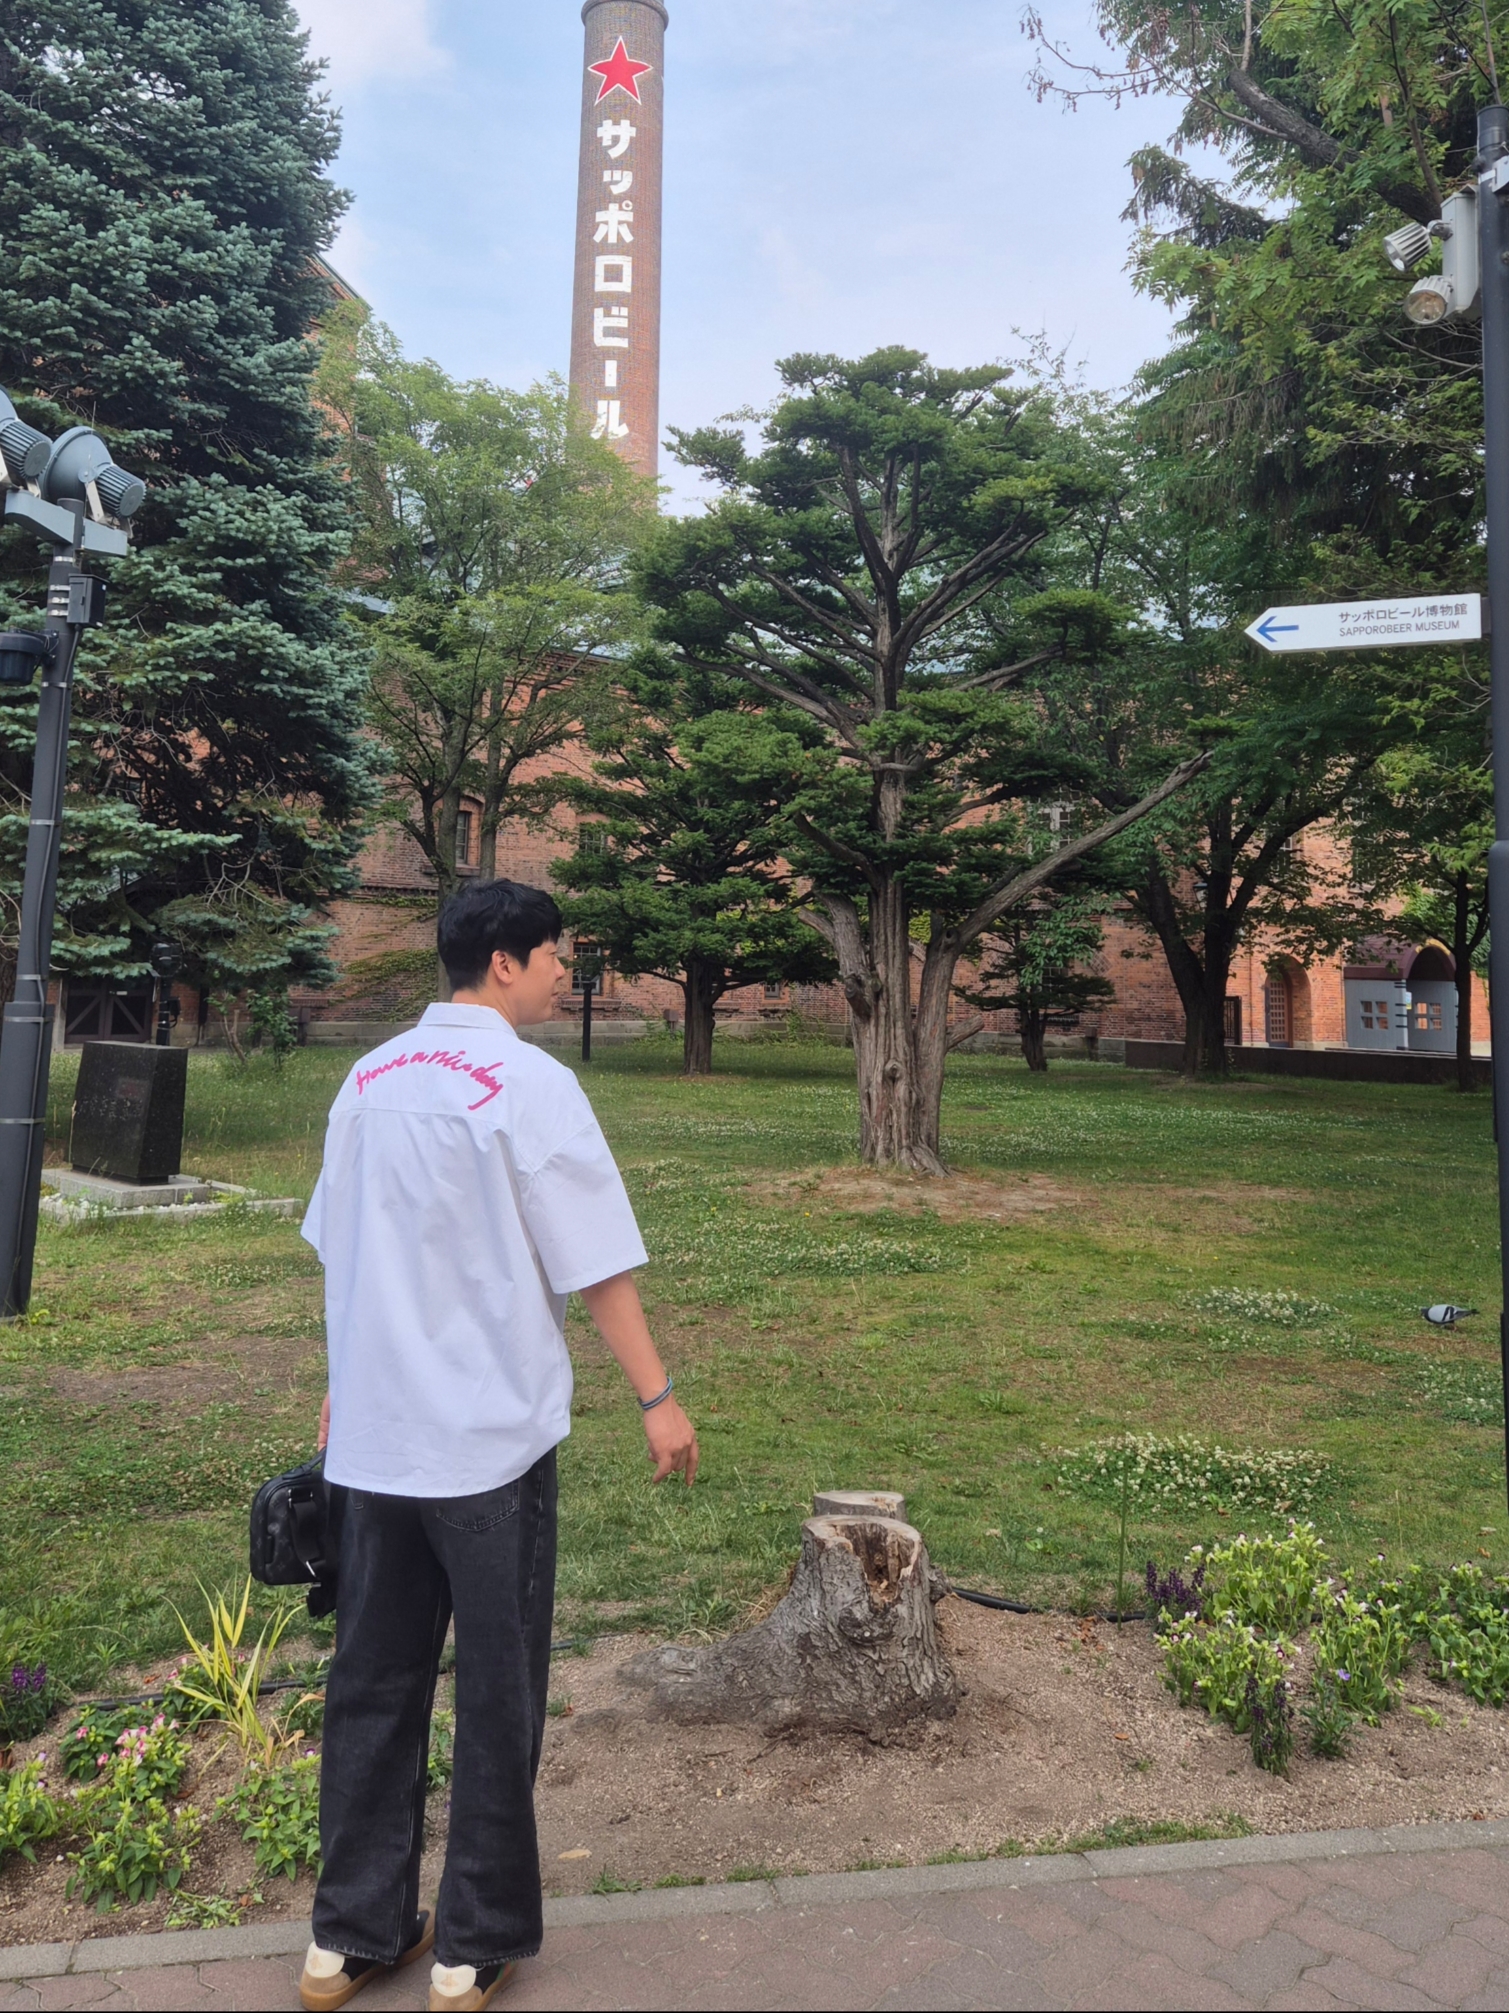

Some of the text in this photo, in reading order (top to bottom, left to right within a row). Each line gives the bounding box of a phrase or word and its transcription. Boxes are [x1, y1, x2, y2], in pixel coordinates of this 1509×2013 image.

[590, 119, 636, 440] サッポロビール
[1338, 603, 1468, 624] サッポロビール博物館
[1339, 620, 1460, 637] SAPPOROBEER MUSEUM
